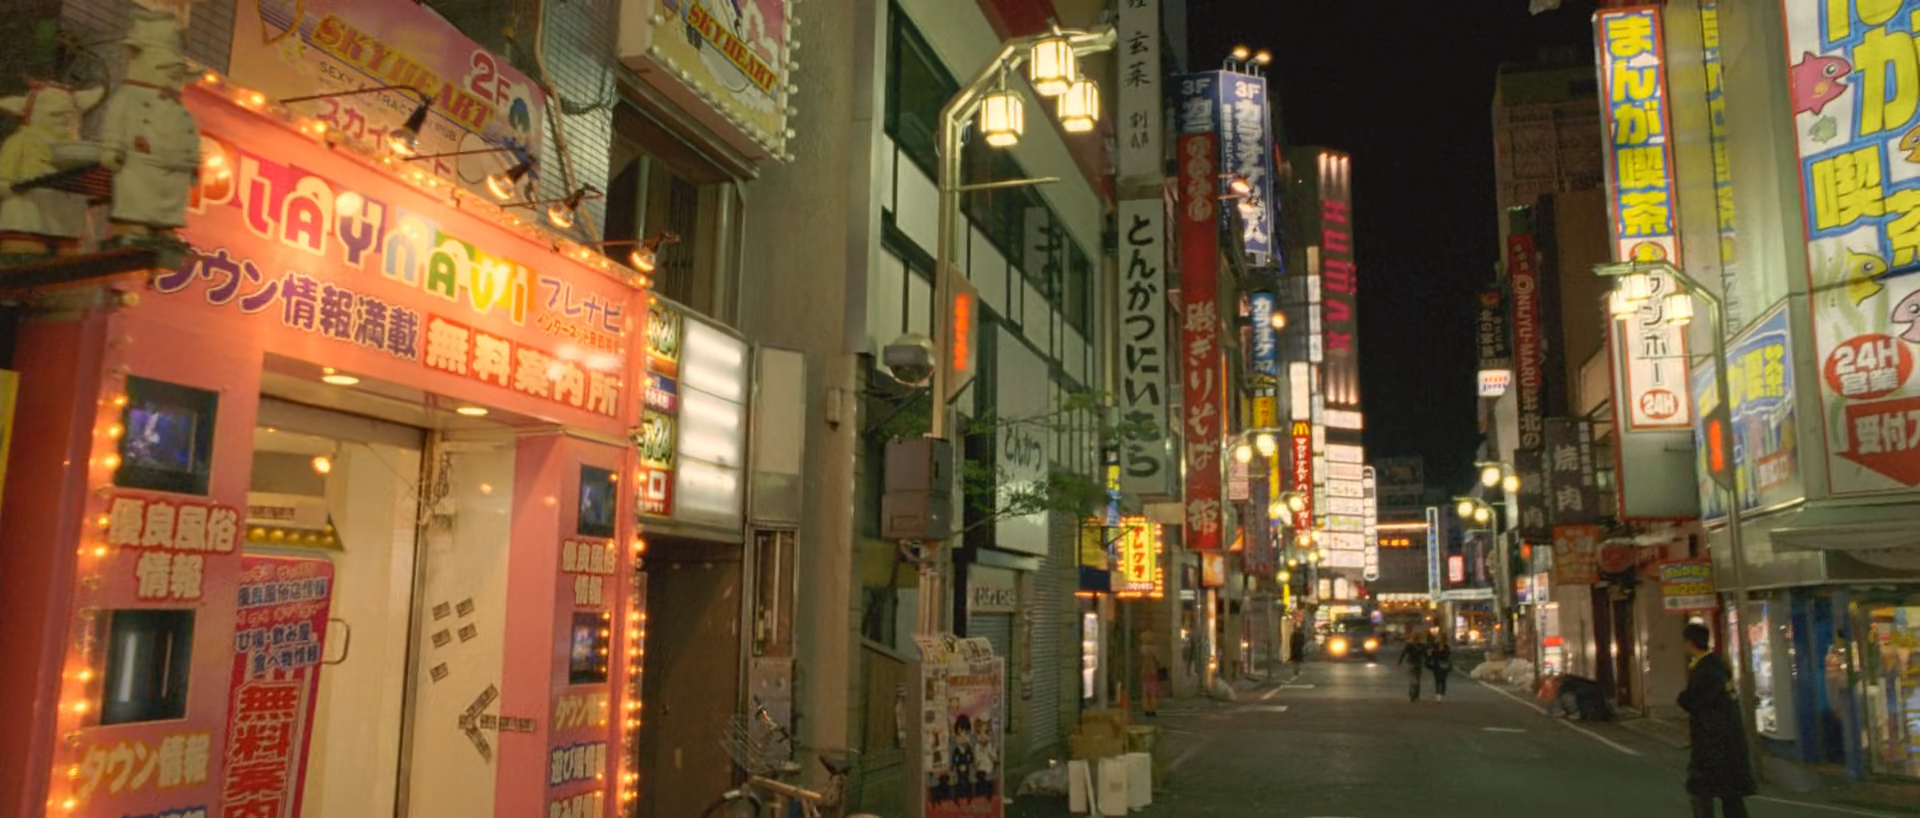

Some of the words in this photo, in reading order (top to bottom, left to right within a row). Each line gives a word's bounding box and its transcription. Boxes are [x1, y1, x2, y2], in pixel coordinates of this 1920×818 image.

[319, 61, 353, 85] SEXY
[471, 50, 512, 103] 2F
[1182, 78, 1210, 95] 3F
[1235, 81, 1261, 98] 3F
[316, 98, 451, 176] スカイト
[1607, 14, 1668, 236] まんが喫茶
[428, 318, 619, 417] 無料案内所
[1834, 338, 1899, 374] 24H
[1840, 367, 1899, 395] 営業
[1643, 392, 1675, 416] 24H
[137, 551, 203, 598] 情報
[79, 734, 211, 803] タウン情報
